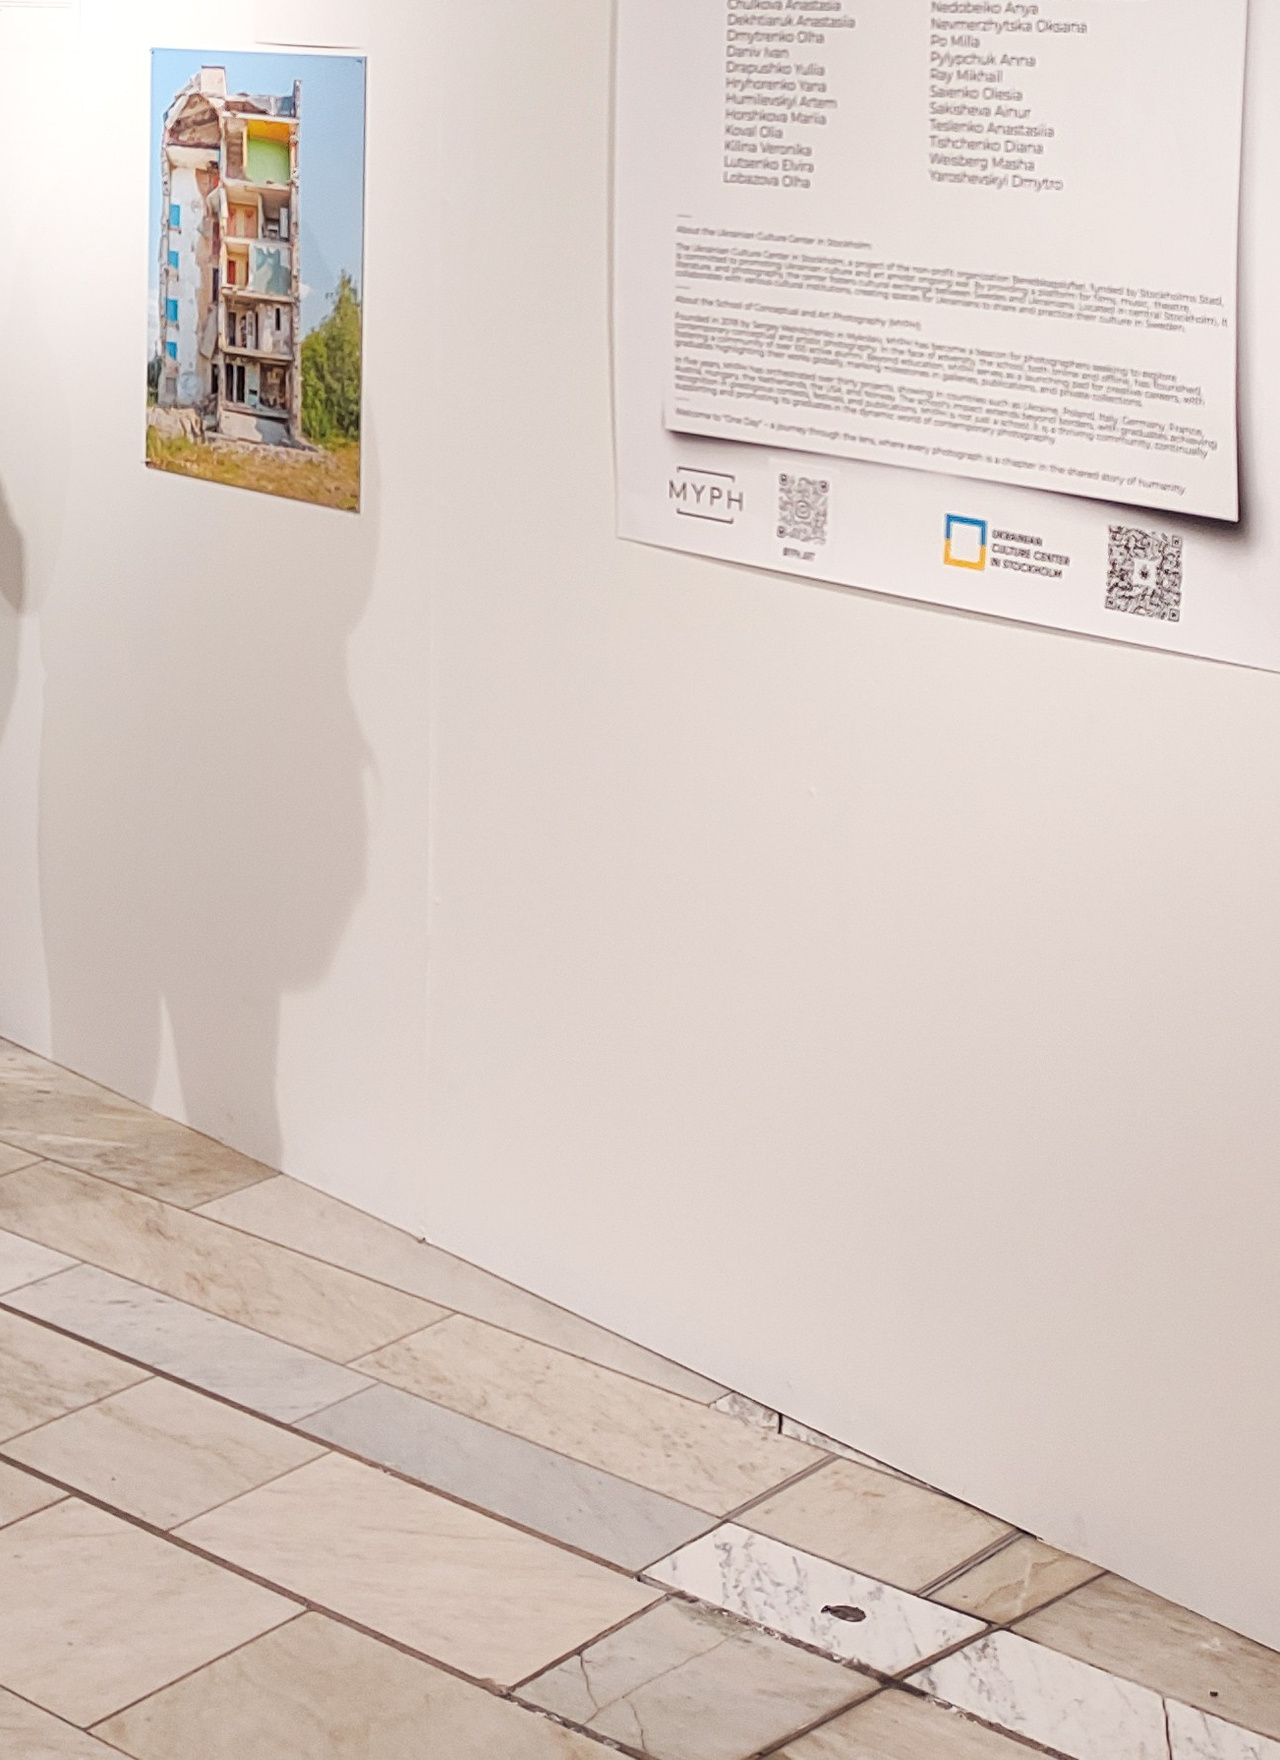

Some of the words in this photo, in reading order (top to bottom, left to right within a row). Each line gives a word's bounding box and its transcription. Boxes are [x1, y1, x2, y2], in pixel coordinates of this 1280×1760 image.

[668, 479, 744, 512] MYPH
[992, 529, 1043, 547] UKRAINIAN
[991, 543, 1031, 560] CULTURE
[1033, 550, 1071, 566] CENTER
[1002, 559, 1063, 578] STOCKHOLM
